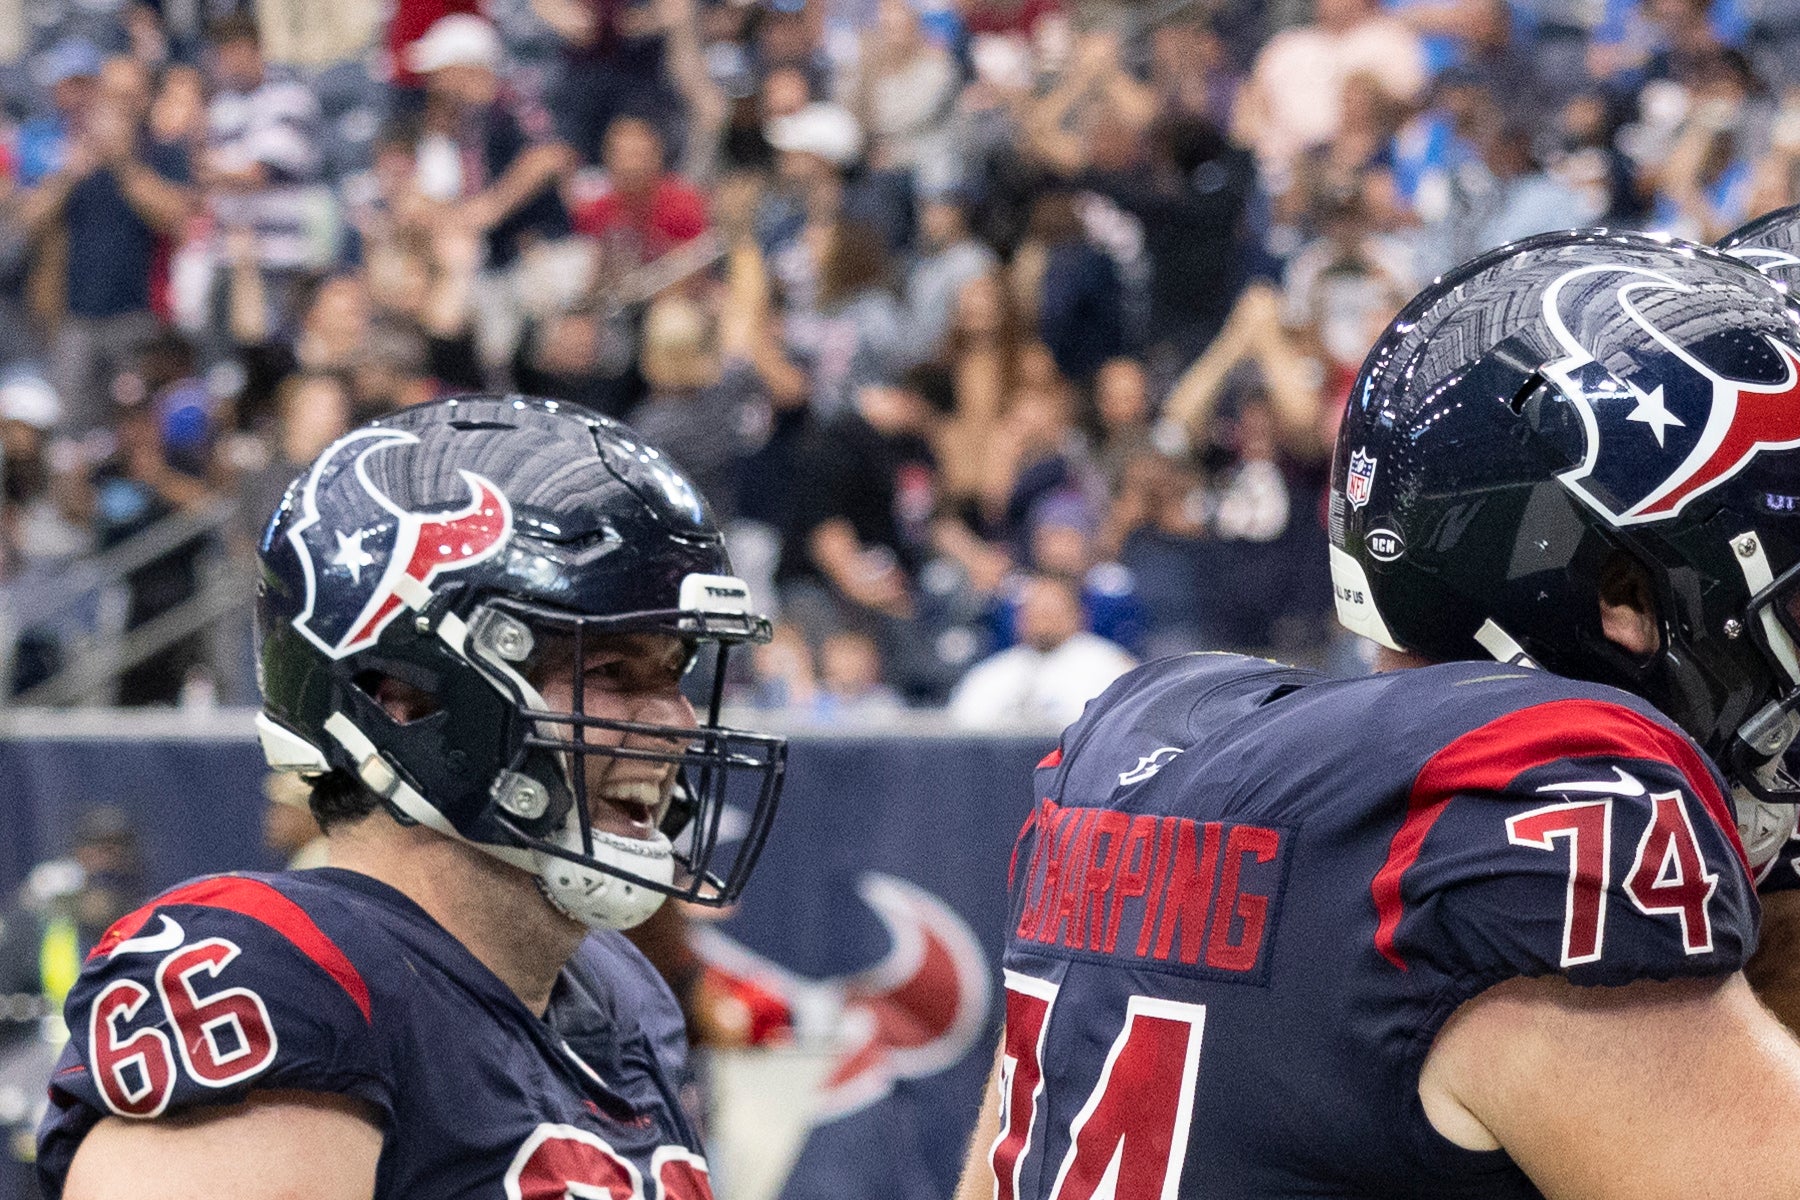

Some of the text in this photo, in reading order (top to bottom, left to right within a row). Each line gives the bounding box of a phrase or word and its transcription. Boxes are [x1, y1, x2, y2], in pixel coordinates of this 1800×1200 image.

[1349, 474, 1366, 499] NFL
[1371, 537, 1396, 554] RCM
[1505, 790, 1719, 967] 74
[89, 937, 278, 1119] 66
